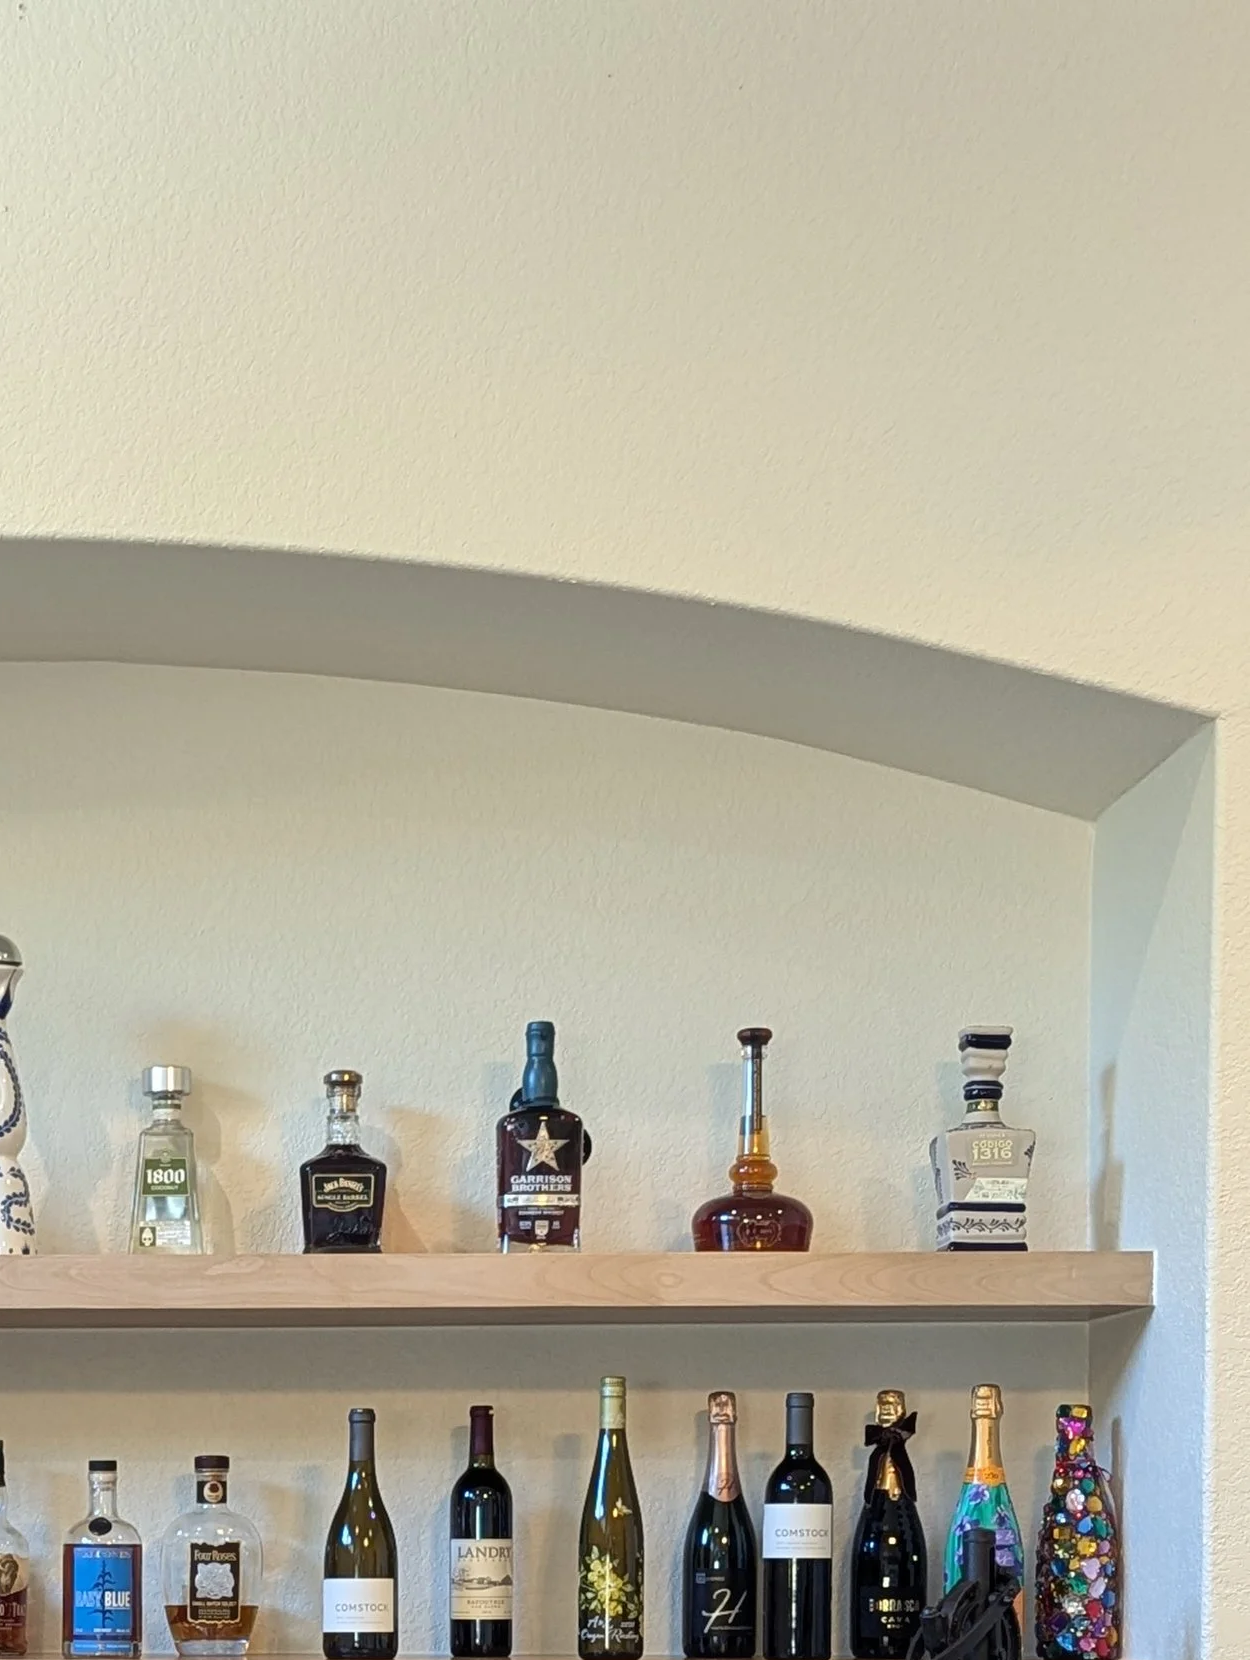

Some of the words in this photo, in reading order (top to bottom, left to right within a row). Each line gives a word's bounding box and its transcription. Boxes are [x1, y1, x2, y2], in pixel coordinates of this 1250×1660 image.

[145, 1168, 185, 1184] 1800
[510, 1174, 572, 1184] GARRISON
[511, 1183, 572, 1192] BROTHERS
[774, 1528, 830, 1538] COMSTOCK
[457, 1545, 512, 1558] LANDRY
[103, 1590, 131, 1608] BLUE
[334, 1603, 390, 1612] COMSTOCK
[880, 1616, 911, 1624] CAVA
